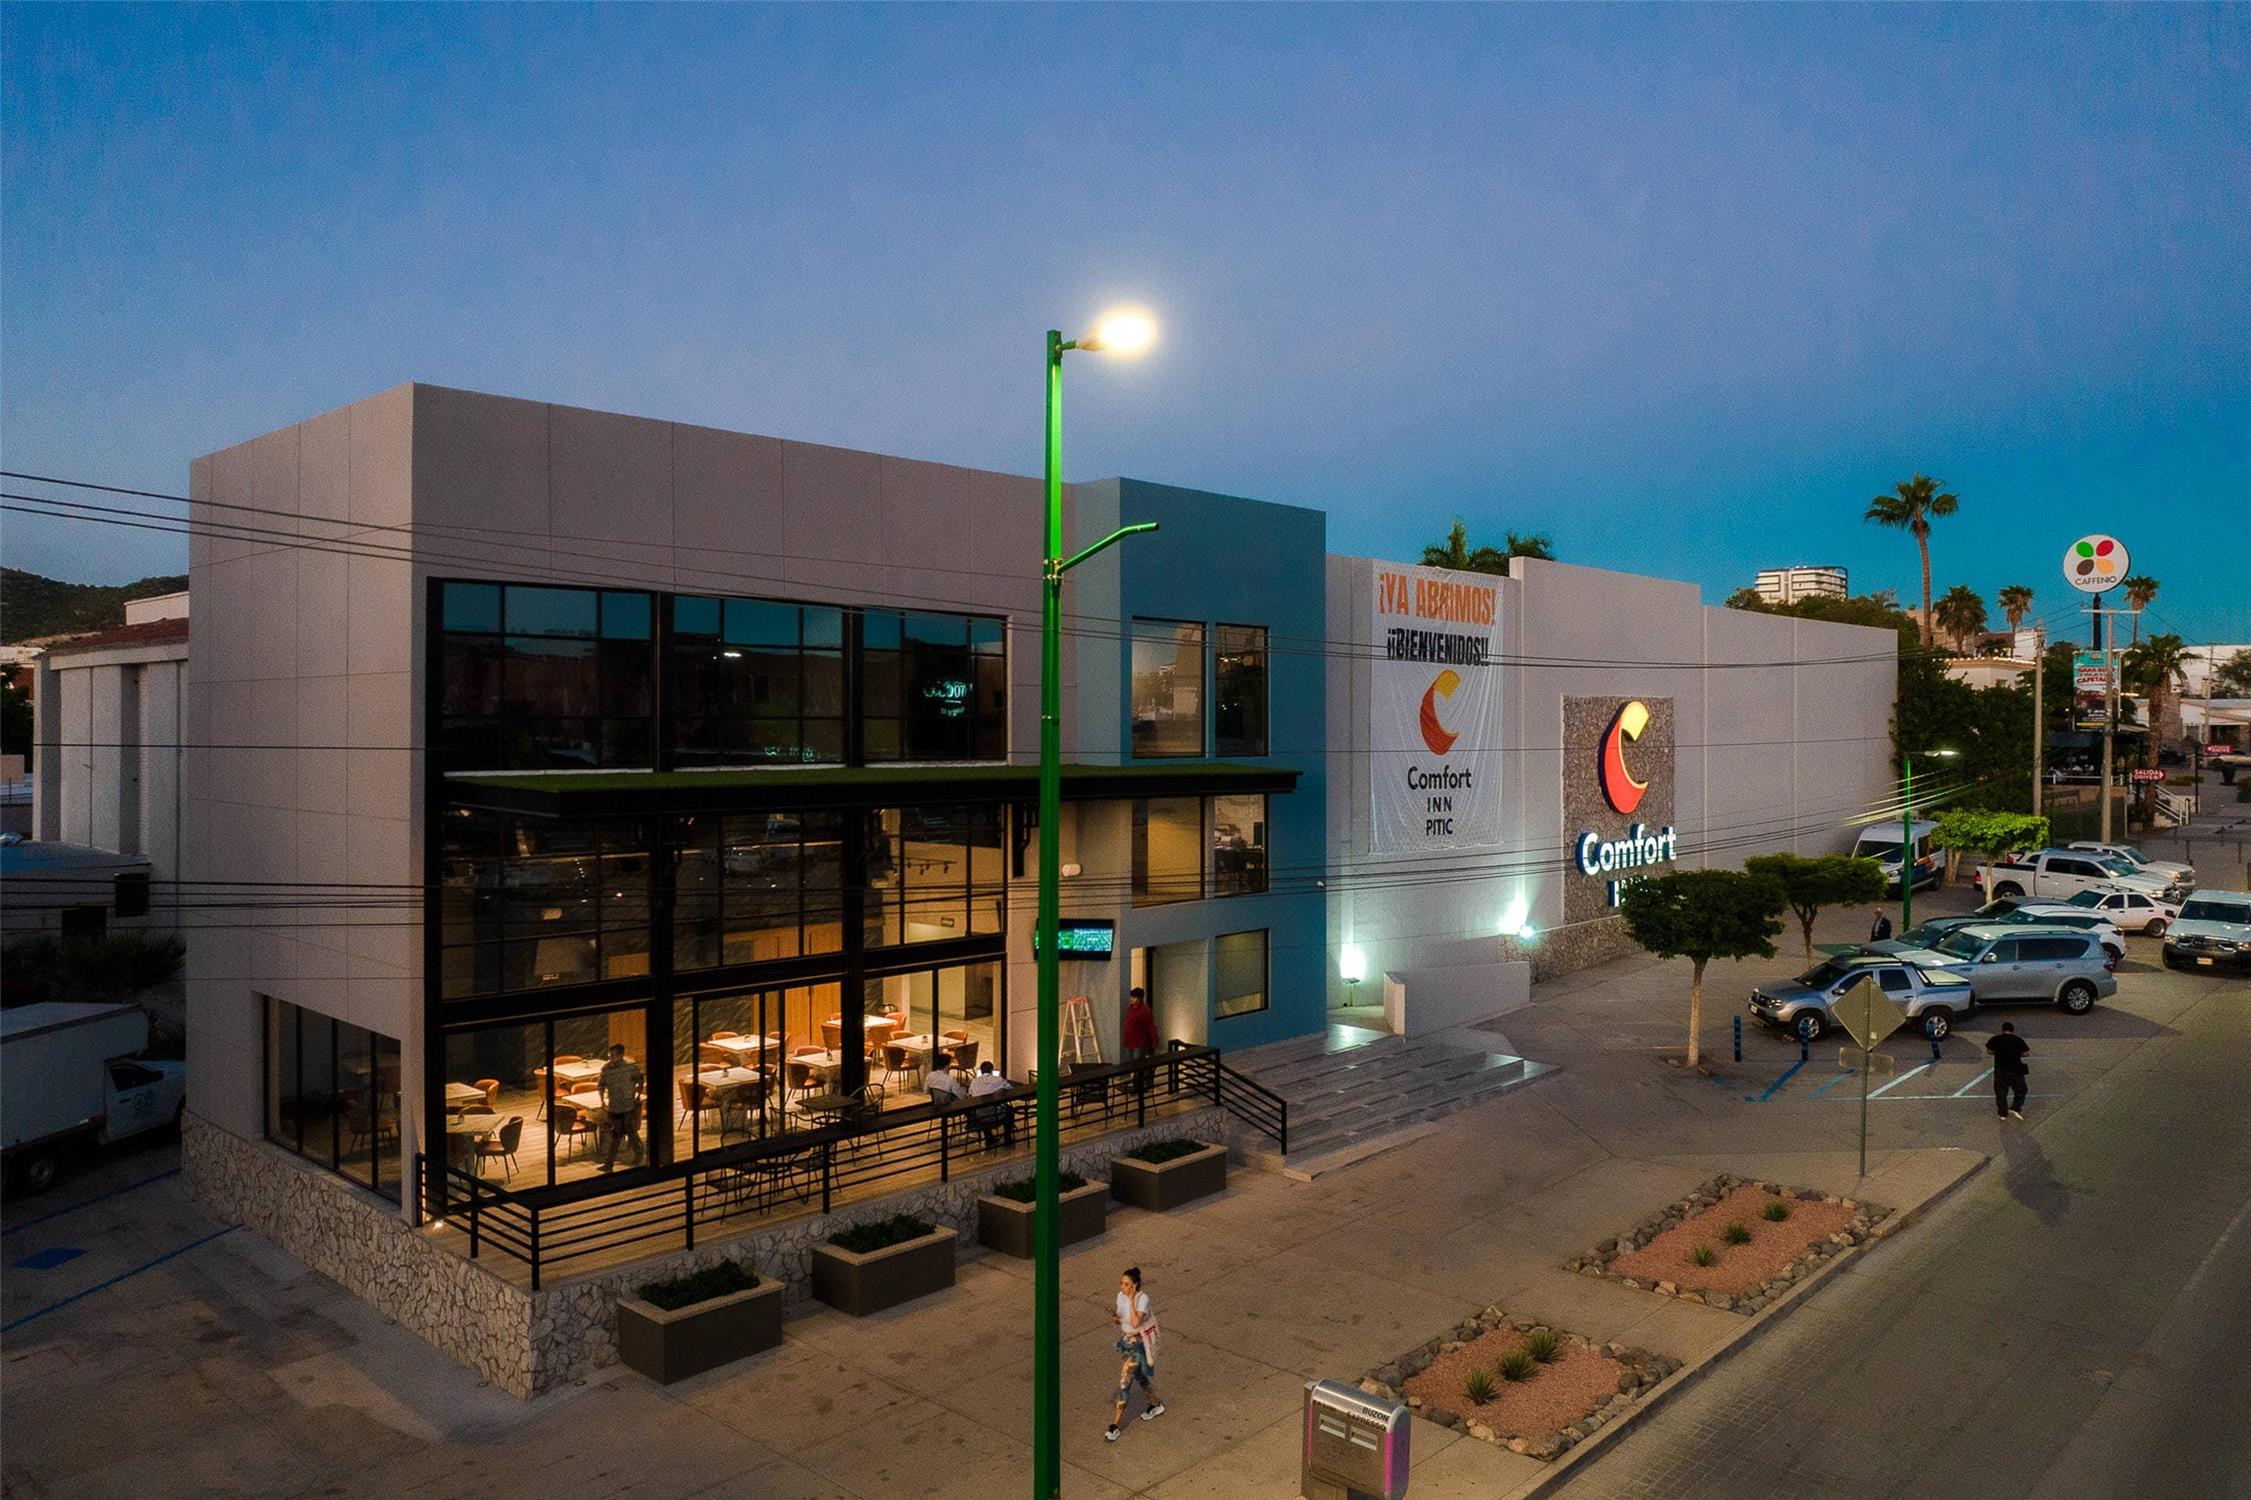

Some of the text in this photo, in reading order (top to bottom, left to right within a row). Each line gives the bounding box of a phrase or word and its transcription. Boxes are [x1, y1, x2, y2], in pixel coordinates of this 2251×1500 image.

[2075, 576, 2117, 586] CAFFENIO
[1379, 572, 1497, 626] ¡YA ABRIMOS!
[1387, 627, 1489, 667] ¡¡BIENVENIDOS!!
[1407, 764, 1472, 790] Comfort
[1427, 796, 1452, 813] INN
[1426, 817, 1453, 836] PITIC
[1579, 822, 1677, 876] Comfort
[1361, 1406, 1390, 1423] BUZON
